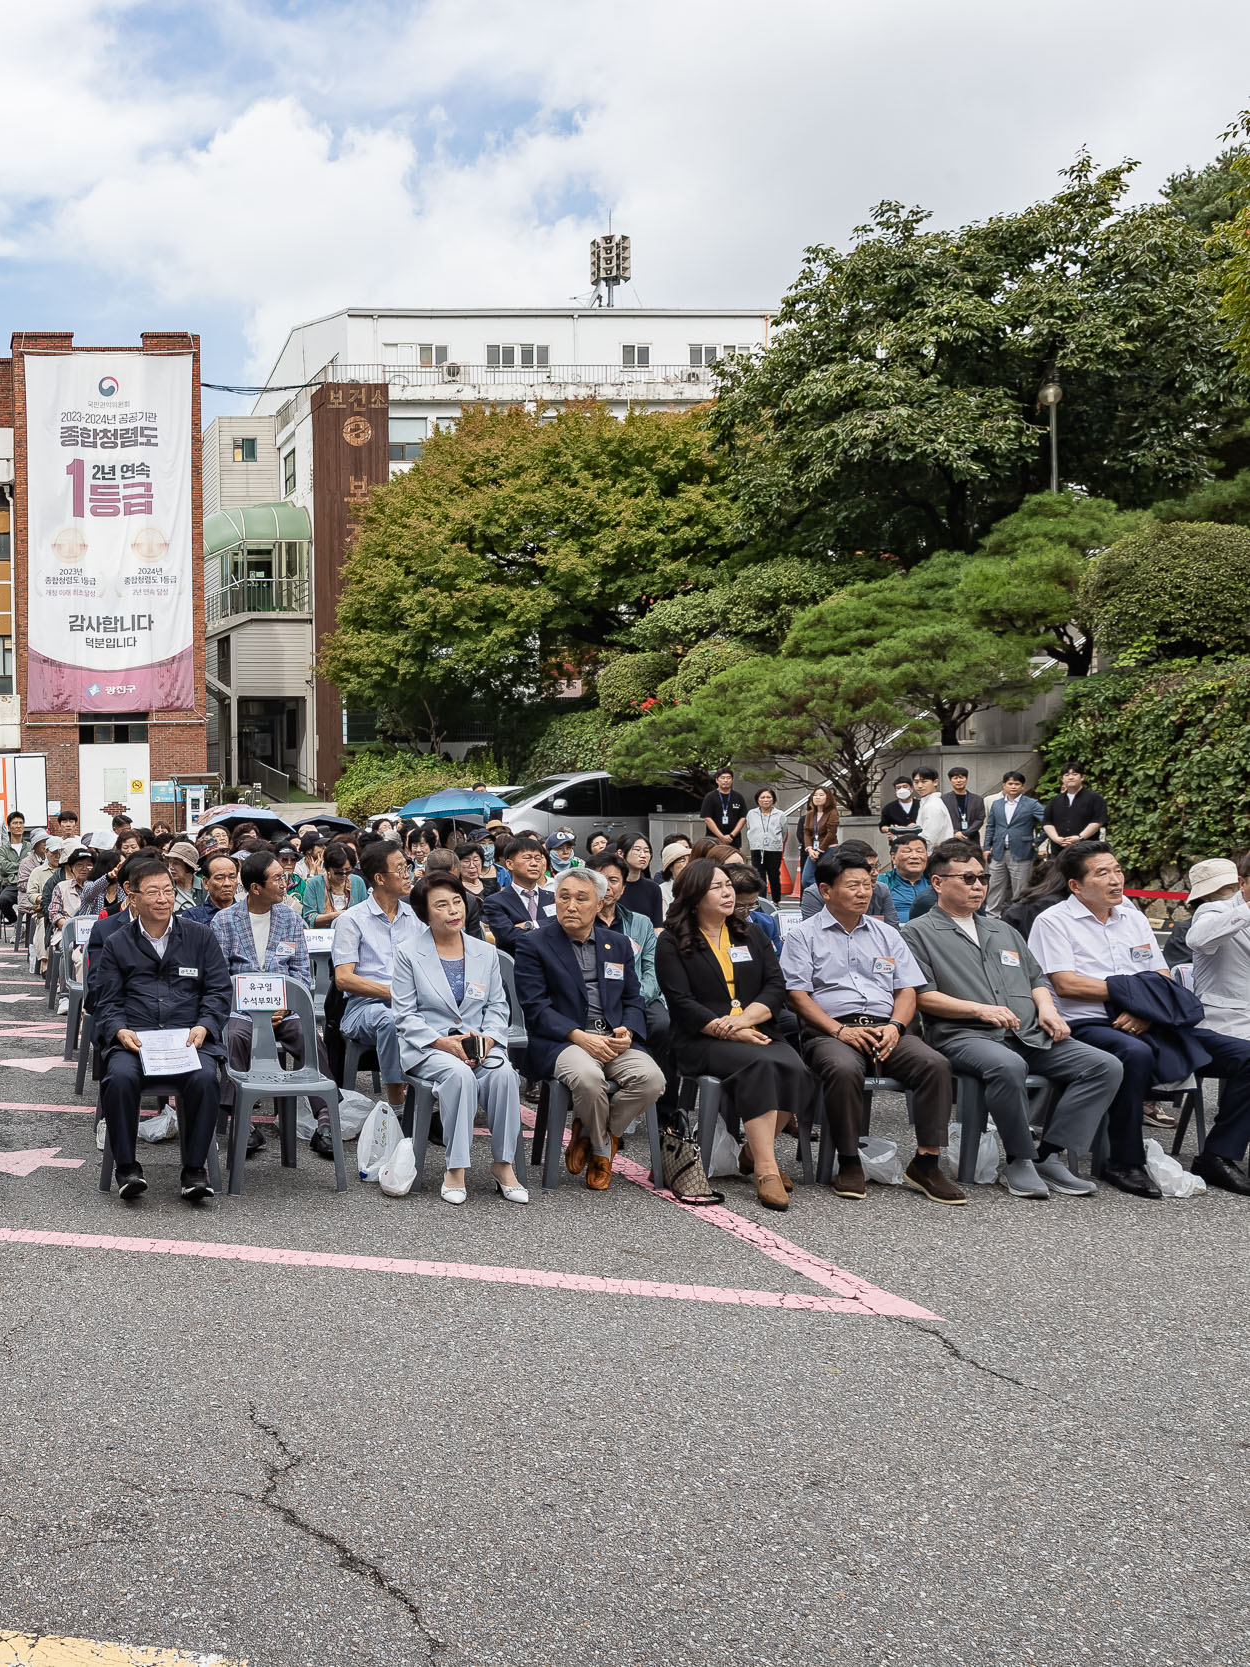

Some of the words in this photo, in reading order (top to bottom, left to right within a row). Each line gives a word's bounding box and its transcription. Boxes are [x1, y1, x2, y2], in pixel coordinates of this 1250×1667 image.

[326, 388, 389, 412] 보건소
[118, 411, 157, 424] 공공기관
[60, 425, 159, 450] 종합청렴도
[91, 464, 116, 481] 2년
[120, 462, 151, 480] 연속
[66, 458, 85, 519] 1
[89, 481, 154, 518] 등급
[59, 568, 83, 577] 2023년
[137, 567, 163, 576] 2024년
[44, 576, 80, 585] 종합청렴도
[81, 577, 97, 586] 1등급
[124, 576, 159, 585] 종합청렴도
[160, 575, 177, 584] 1등급
[68, 614, 154, 633] 감사합니다
[85, 637, 138, 649] 덕분입니다
[104, 685, 137, 695] 광진구
[242, 997, 282, 1006] 수석부회장
